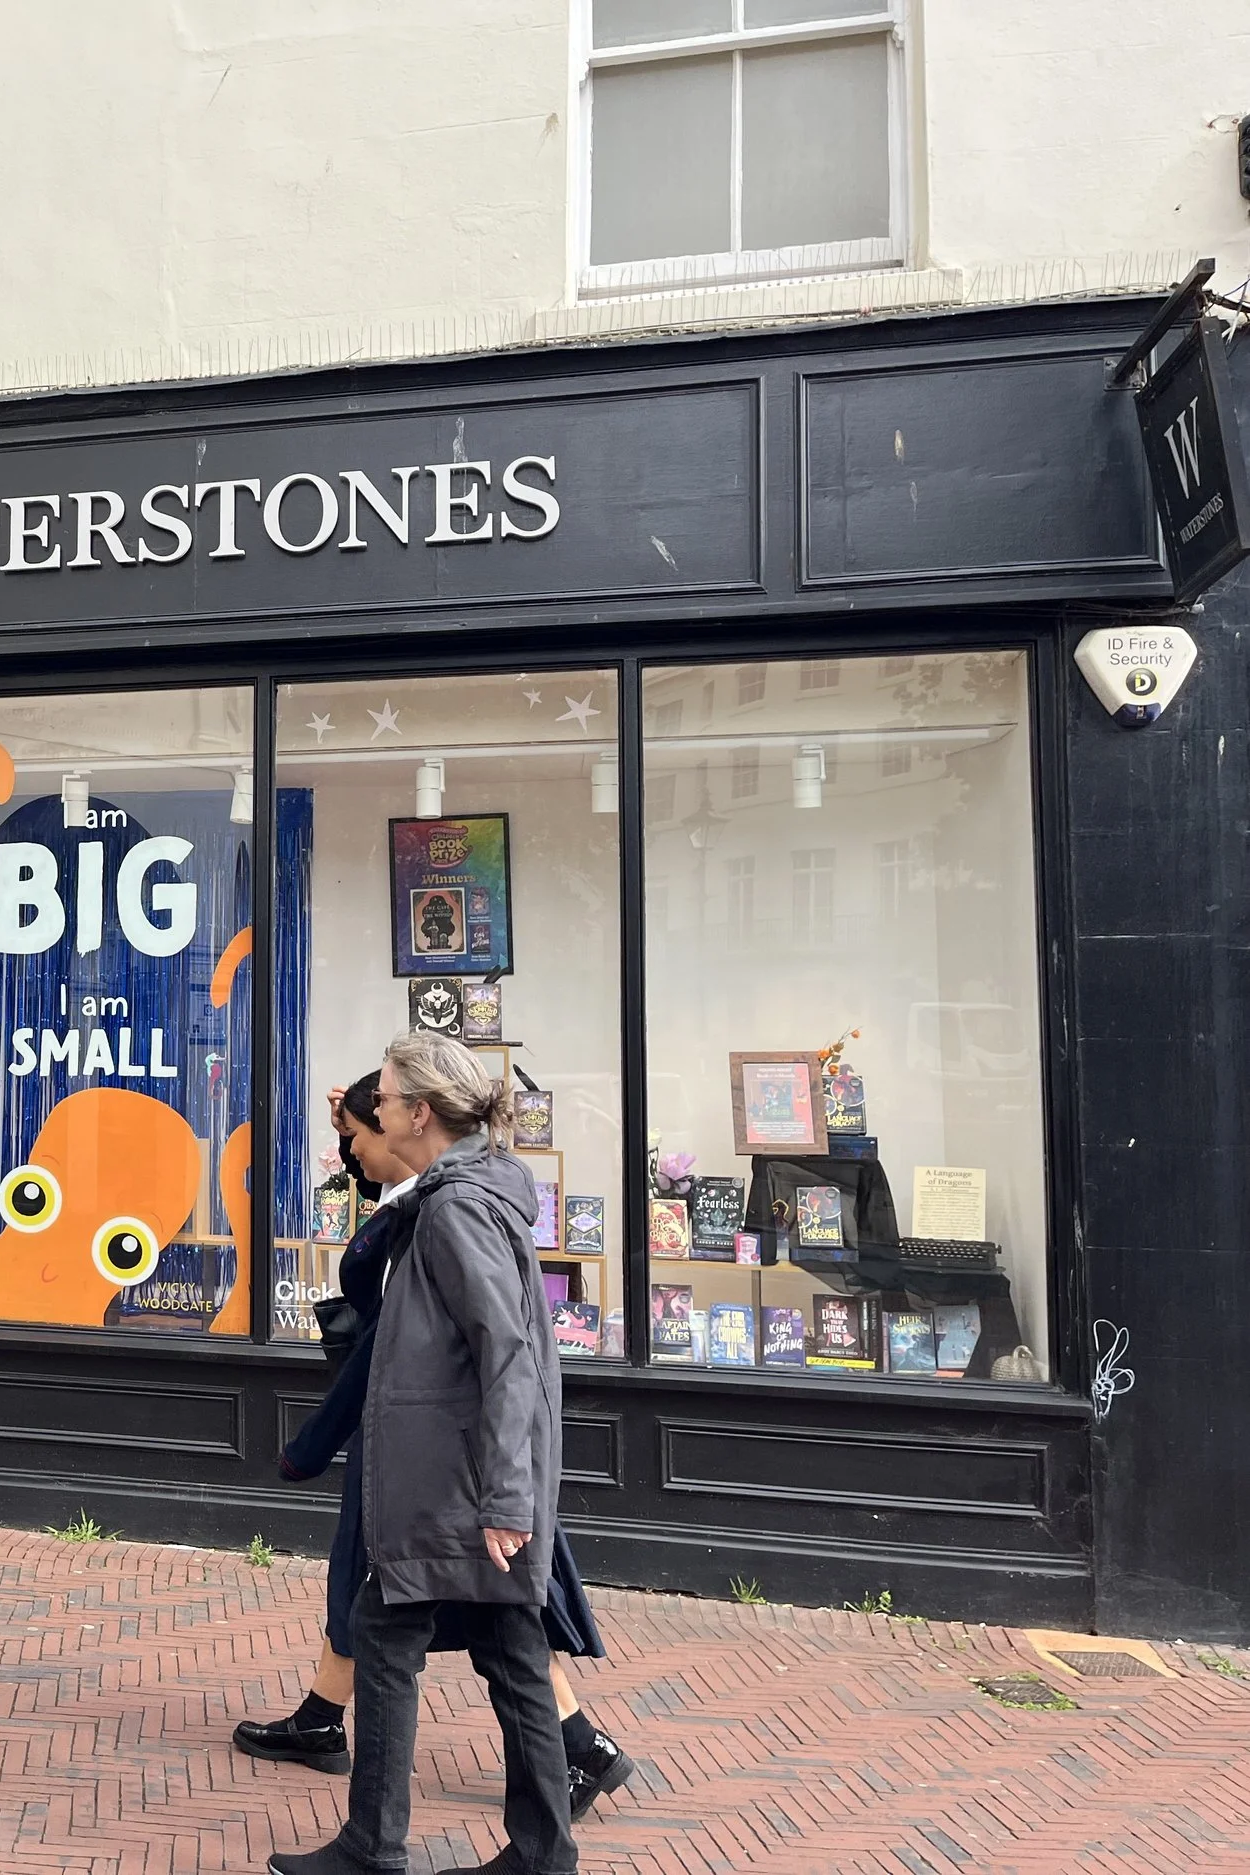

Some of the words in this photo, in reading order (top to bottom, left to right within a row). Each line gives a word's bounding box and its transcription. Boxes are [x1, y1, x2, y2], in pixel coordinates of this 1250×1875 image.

[1163, 396, 1199, 499] W
[1180, 492, 1224, 545] WATERSTONES
[1107, 638, 1124, 650] ID
[1129, 637, 1158, 650] Fire
[1162, 636, 1174, 650] &
[1110, 652, 1172, 668] Security
[84, 808, 127, 829] am
[429, 836, 468, 851] BOOK
[421, 874, 477, 885] Winners
[60, 983, 67, 1016] I
[81, 995, 128, 1017] am
[7, 1027, 178, 1078] SMALL
[933, 1169, 973, 1178] Language
[938, 1179, 972, 1187] Dragons
[157, 1281, 196, 1294] VICKY
[274, 1280, 337, 1302] Click
[138, 1297, 213, 1313] WOODGATE
[821, 1308, 849, 1320] DARK
[823, 1323, 848, 1334] HIDES
[831, 1332, 843, 1344] US
